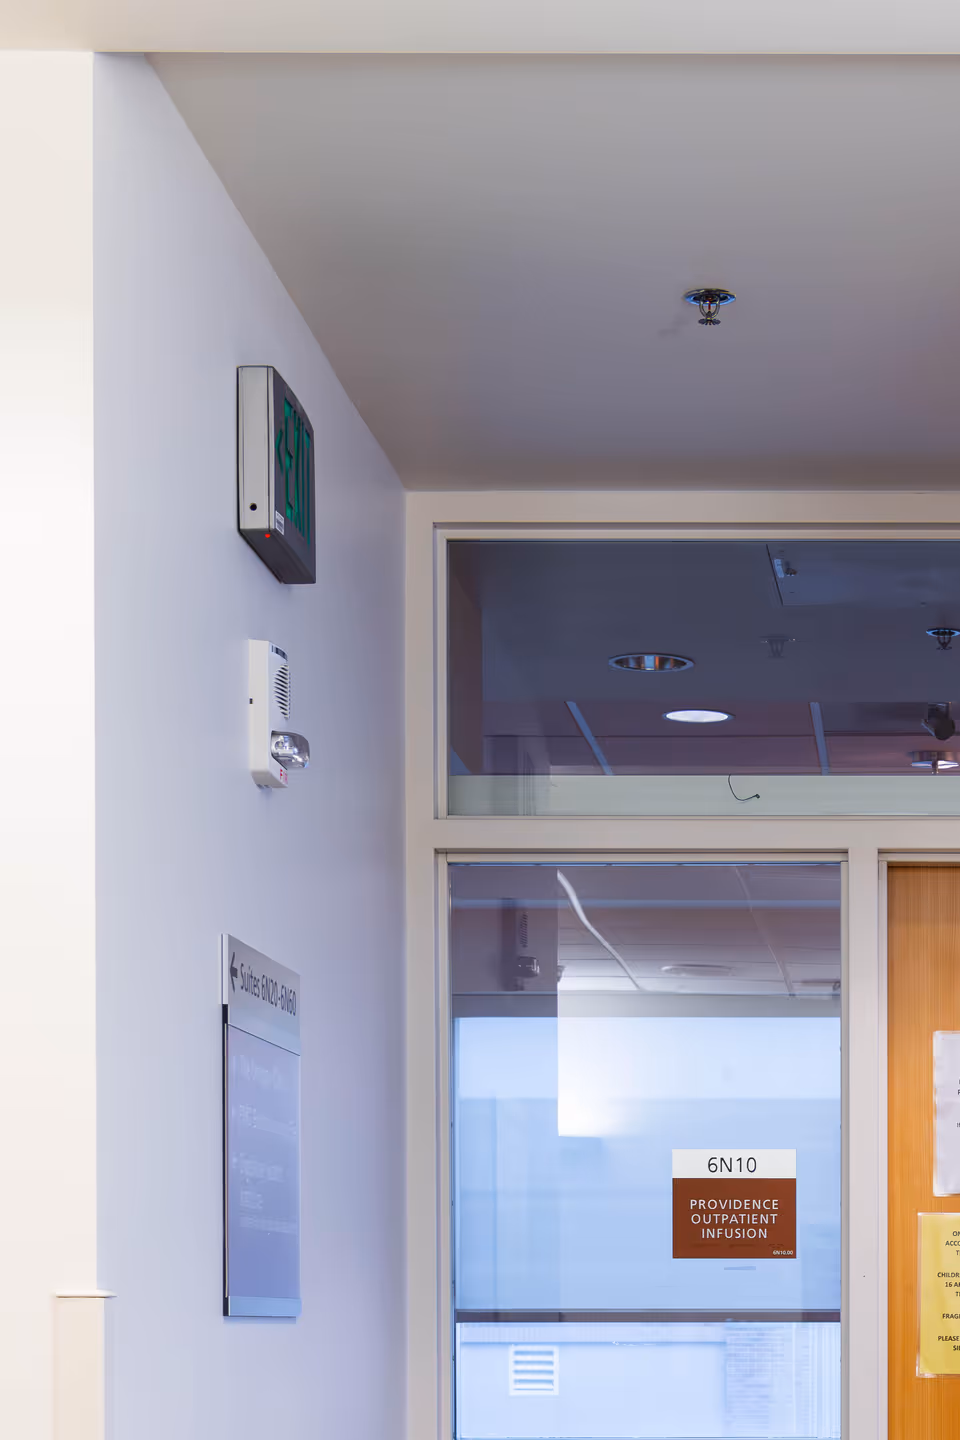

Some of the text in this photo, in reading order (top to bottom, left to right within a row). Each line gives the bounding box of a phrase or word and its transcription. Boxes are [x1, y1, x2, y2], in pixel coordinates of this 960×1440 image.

[284, 397, 310, 545] EXIT
[240, 963, 260, 998] Suites
[708, 1157, 757, 1173] 6N10
[690, 1199, 779, 1210] PROVIDENCE
[691, 1214, 778, 1224] OUTPATIENT
[702, 1228, 767, 1238] INFUSION
